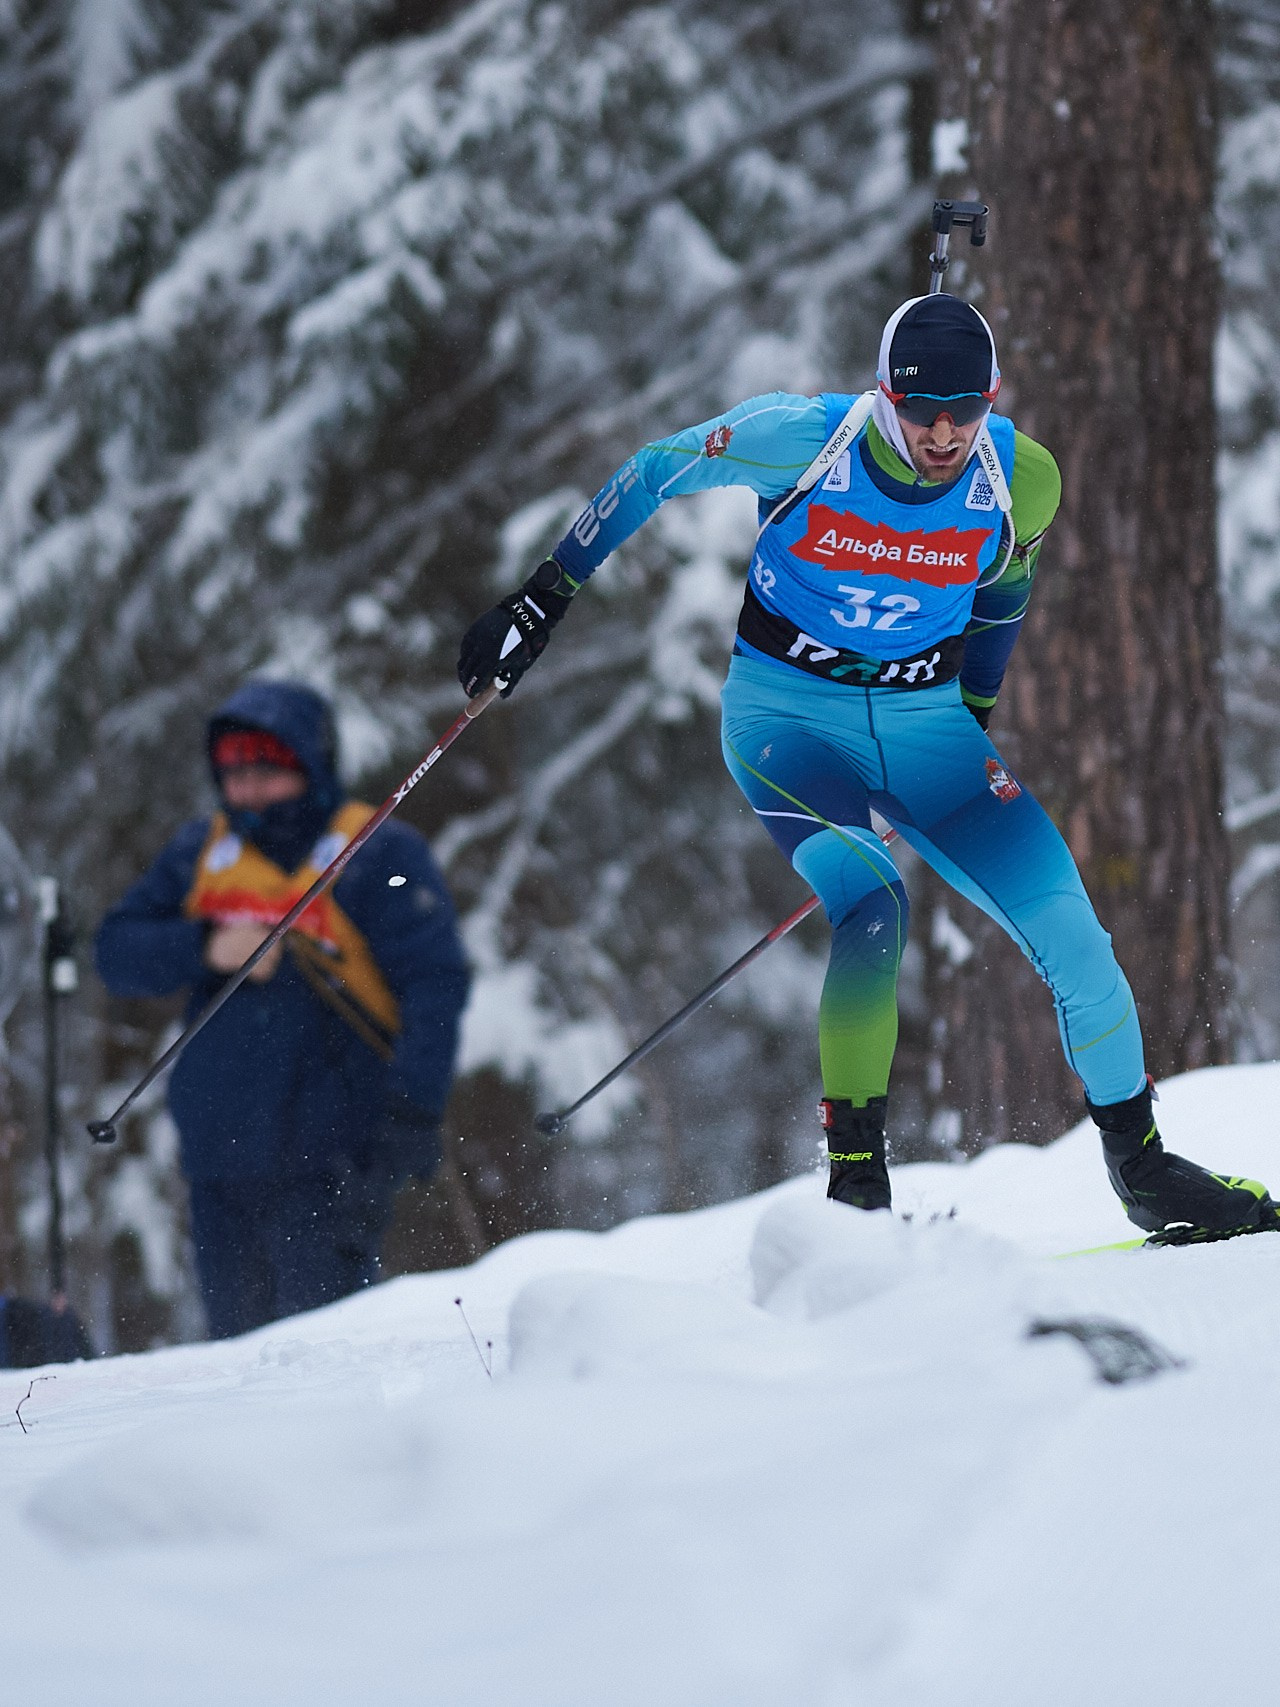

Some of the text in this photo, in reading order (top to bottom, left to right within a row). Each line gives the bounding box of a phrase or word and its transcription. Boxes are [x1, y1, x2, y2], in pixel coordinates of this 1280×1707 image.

[894, 365, 919, 378] PARI
[827, 424, 852, 457] LARSEN
[970, 493, 992, 506] 2025
[813, 528, 968, 567] Альфа Банк
[753, 552, 777, 600] 32
[829, 584, 921, 631] 32
